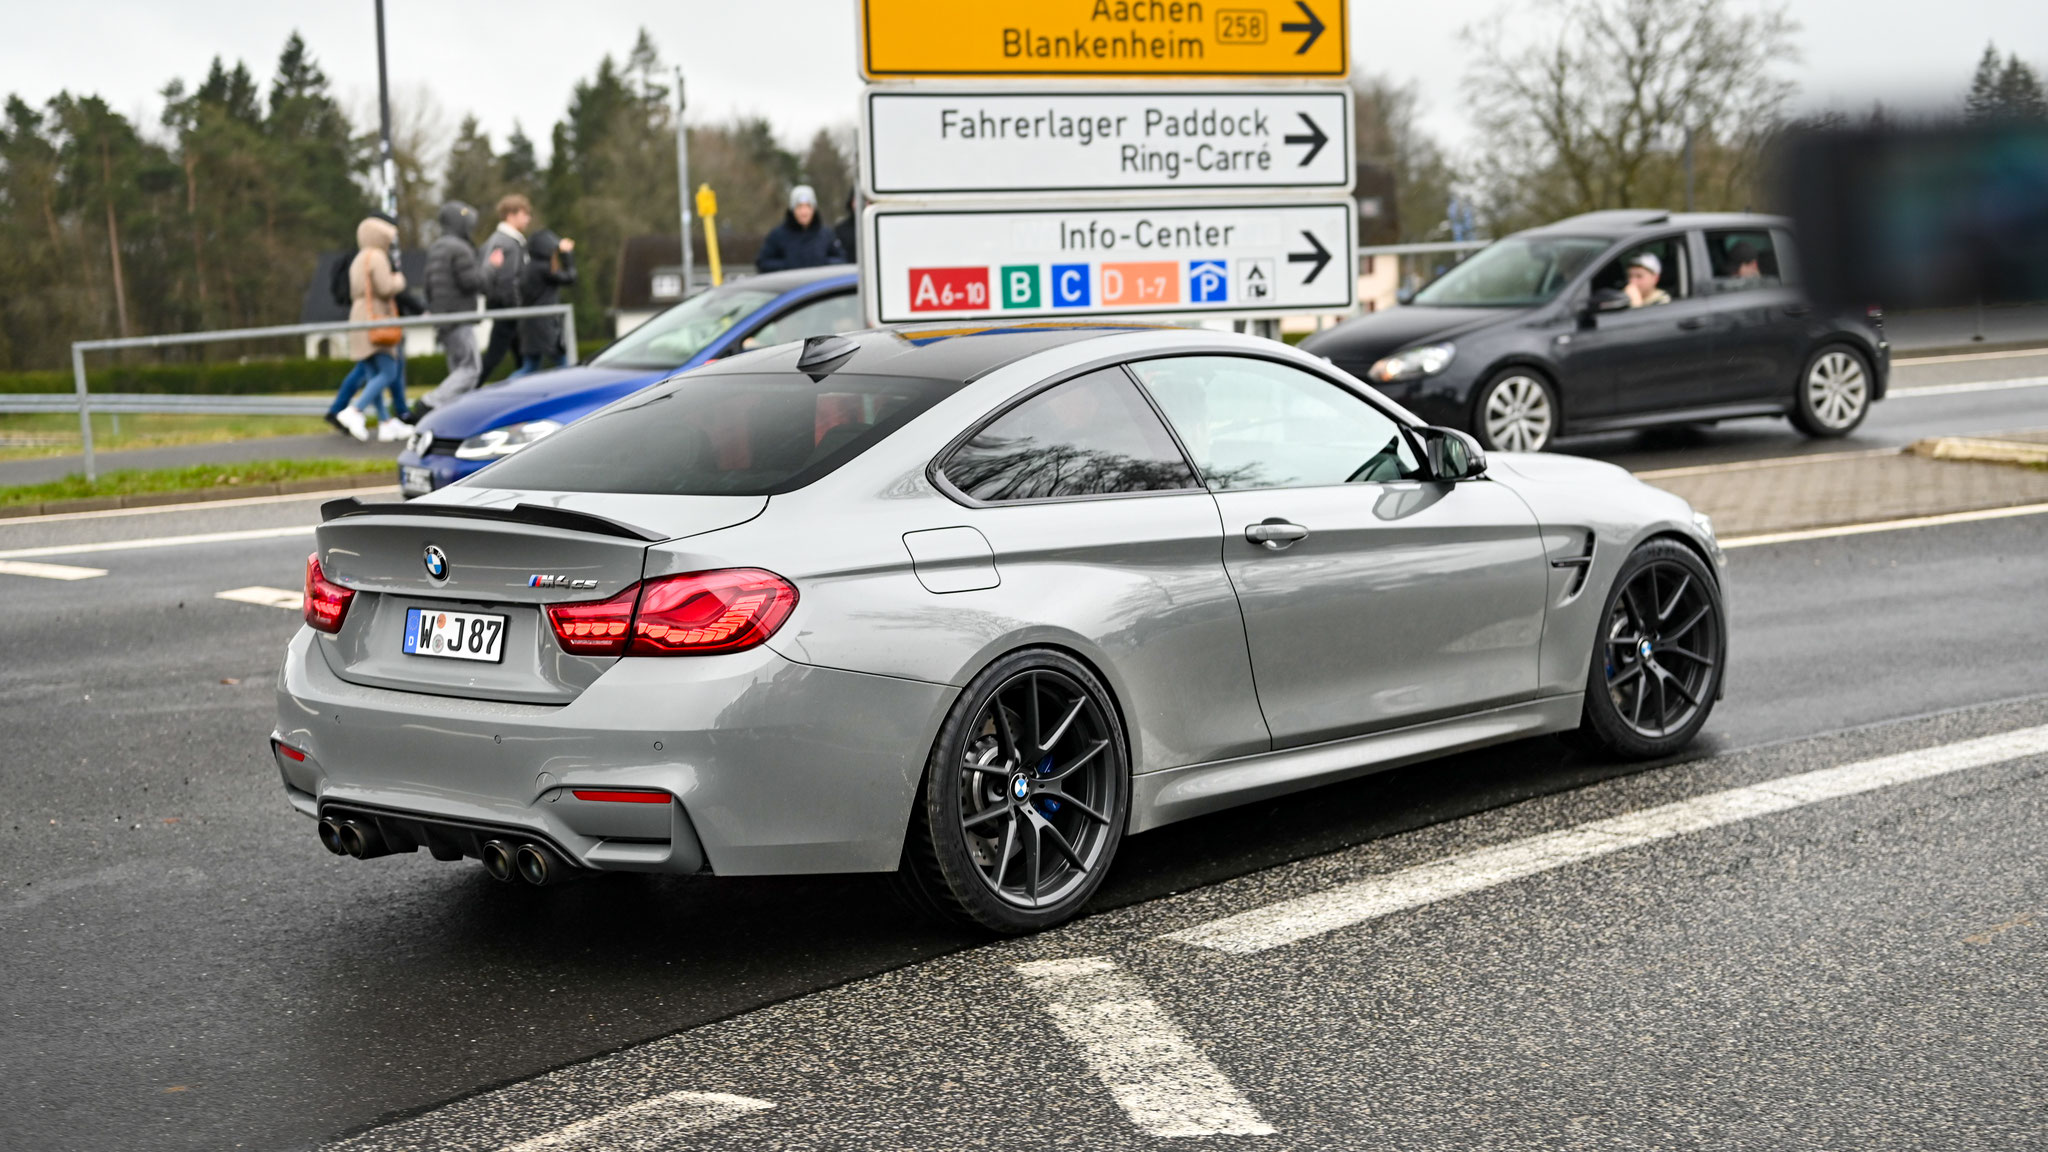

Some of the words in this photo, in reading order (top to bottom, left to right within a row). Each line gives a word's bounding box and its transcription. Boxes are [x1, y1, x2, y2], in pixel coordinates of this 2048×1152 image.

[1091, 0, 1203, 22] Aachen
[1222, 16, 1261, 38] 258
[1003, 29, 1204, 59] Blankenheim
[941, 109, 1128, 146] Fahrerlager
[1145, 108, 1270, 138] Paddock
[1121, 143, 1272, 179] Ring-Carré
[1060, 220, 1235, 251] Info-Center
[1010, 271, 1032, 303] B
[1060, 269, 1082, 302] C
[1103, 270, 1123, 300] D
[1137, 276, 1167, 298] 1-7
[1200, 273, 1220, 297] P
[408, 635, 415, 646] D
[419, 614, 436, 649] W
